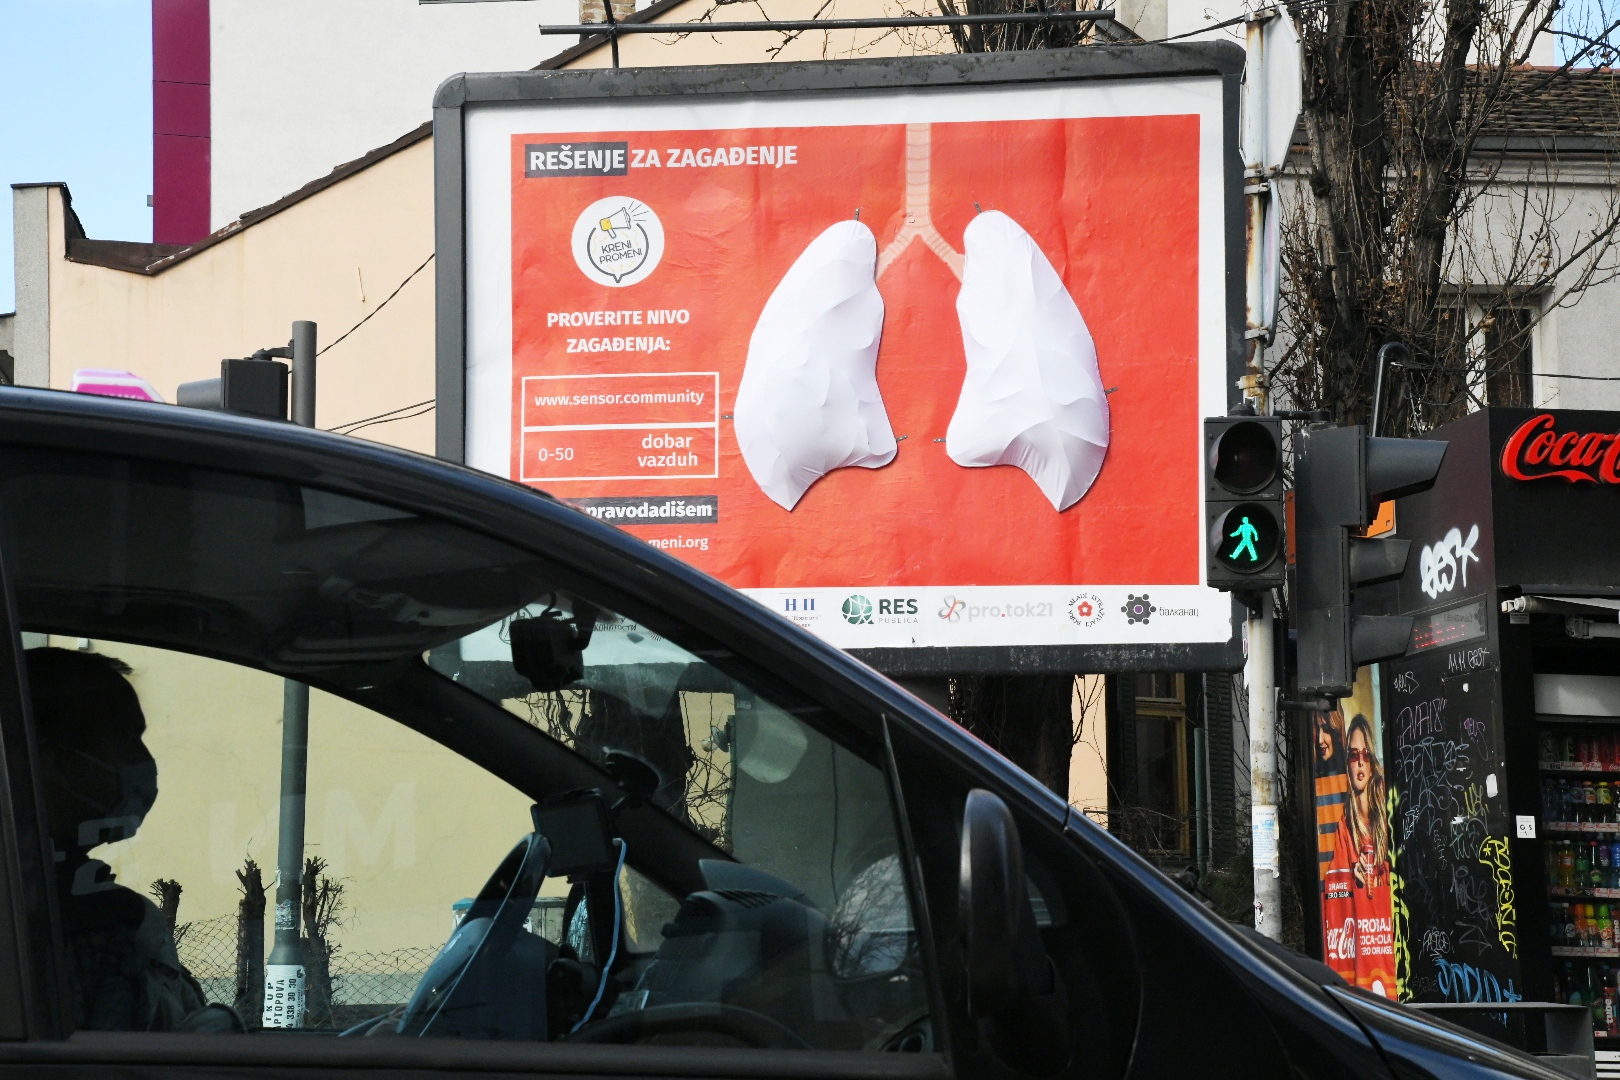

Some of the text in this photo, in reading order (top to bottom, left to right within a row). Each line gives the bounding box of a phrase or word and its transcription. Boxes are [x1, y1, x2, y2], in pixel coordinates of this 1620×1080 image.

[530, 145, 798, 173] REŠENJE ZA ZAGAĐENJE
[601, 240, 632, 255] KRENI
[599, 248, 643, 264] PROMENI
[547, 309, 690, 328] PROVERITE NIVO
[566, 336, 671, 354] ZAGAĐENJA:
[535, 389, 705, 407] www.sensor.community
[641, 433, 693, 449] dobar
[538, 447, 574, 462] 0-50
[637, 452, 698, 468] vazduh
[878, 598, 919, 615] RES
[968, 602, 1053, 622] pro.tok21
[287, 992, 296, 1002] 30
